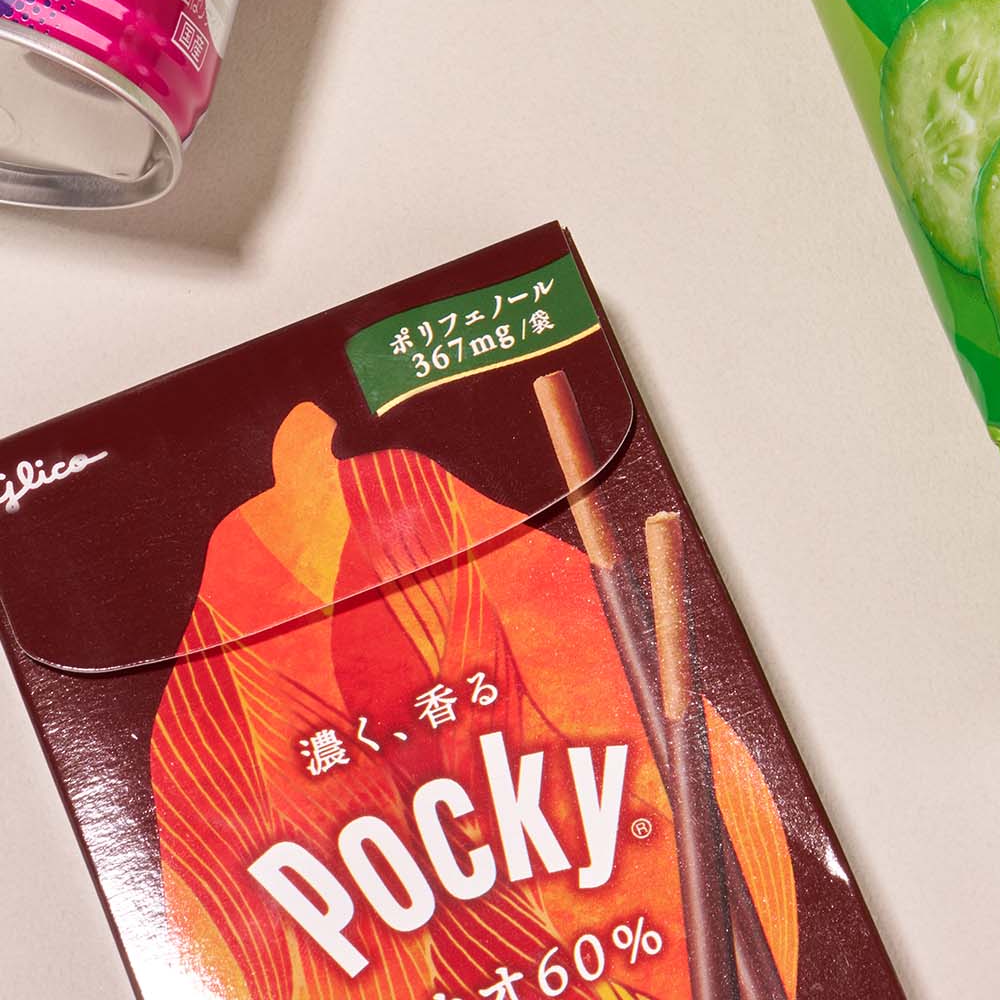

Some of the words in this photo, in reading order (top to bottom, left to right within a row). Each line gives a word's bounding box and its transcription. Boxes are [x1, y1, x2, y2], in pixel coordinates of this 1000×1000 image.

[176, 18, 206, 65] 国産
[389, 277, 555, 355] ポリフェノール
[298, 671, 499, 777] 濃く、香る
[434, 916, 662, 1000] オ60%
